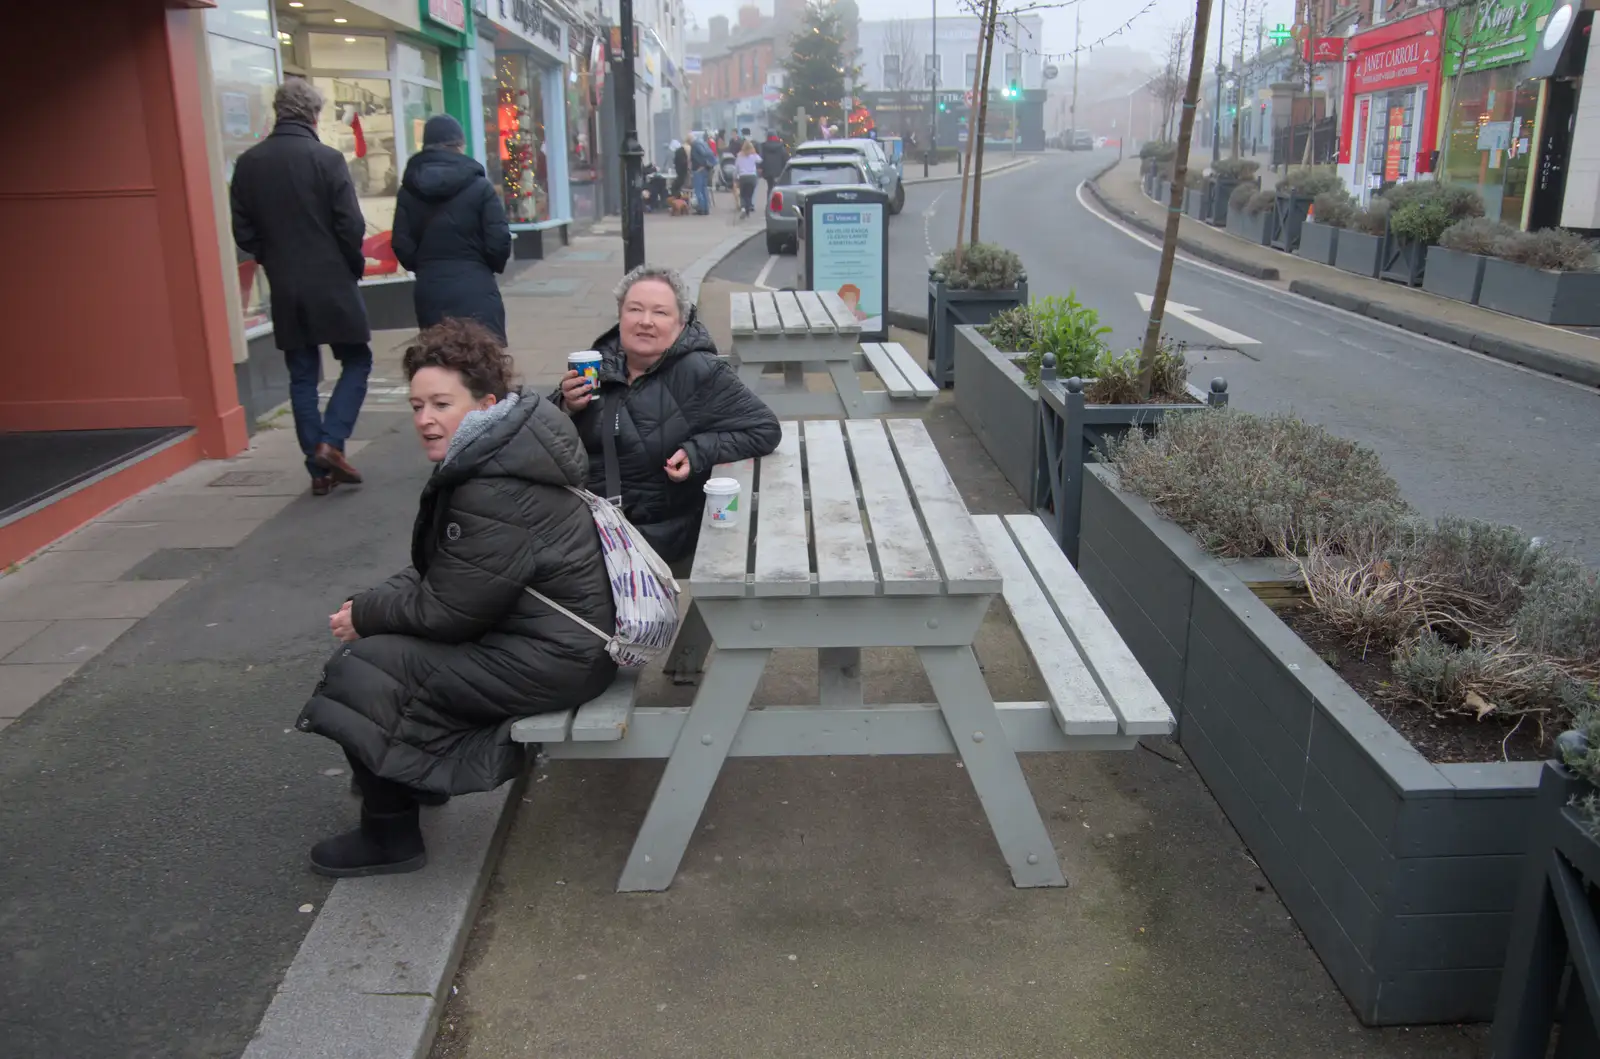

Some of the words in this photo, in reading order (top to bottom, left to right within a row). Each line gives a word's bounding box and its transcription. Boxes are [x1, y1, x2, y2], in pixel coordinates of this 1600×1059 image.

[1479, 0, 1529, 35] Kings
[1363, 51, 1386, 77] JANET
[1385, 42, 1420, 68] CARROLL
